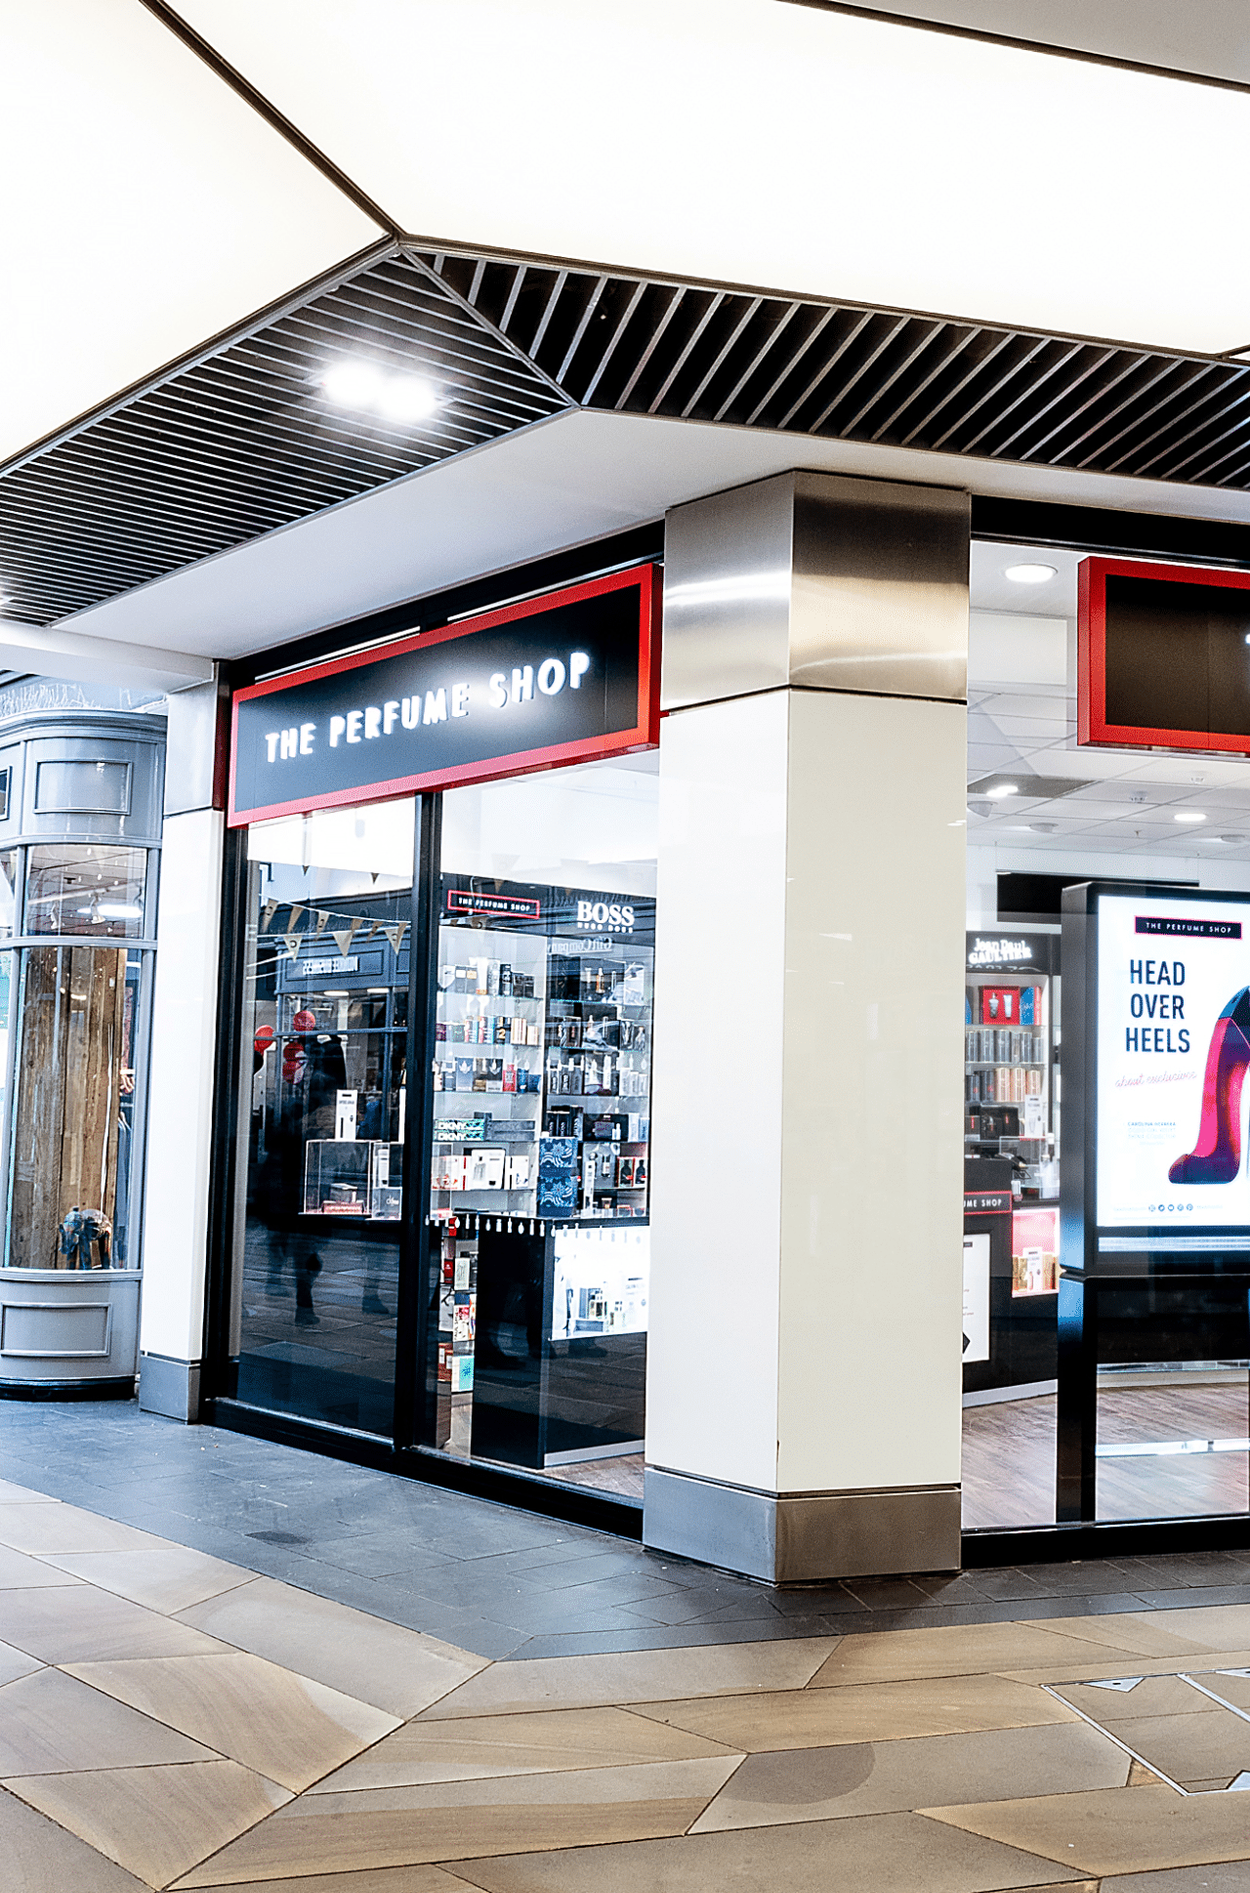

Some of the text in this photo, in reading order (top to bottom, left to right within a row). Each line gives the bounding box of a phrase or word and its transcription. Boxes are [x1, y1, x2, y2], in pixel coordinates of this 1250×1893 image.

[265, 652, 590, 763] THE PERFUME SHOP
[511, 903, 530, 912] SHOP
[577, 901, 634, 926] BOSS
[1146, 922, 1231, 934] THE PERFUME SHOP
[974, 937, 1000, 952] Jean
[1130, 959, 1185, 987] HEAD
[1130, 993, 1185, 1020] OVER
[1125, 1027, 1191, 1054] HEELS
[439, 1121, 467, 1130] DKNY
[438, 1131, 467, 1141] DKNY
[981, 1198, 1002, 1207] SHOP
